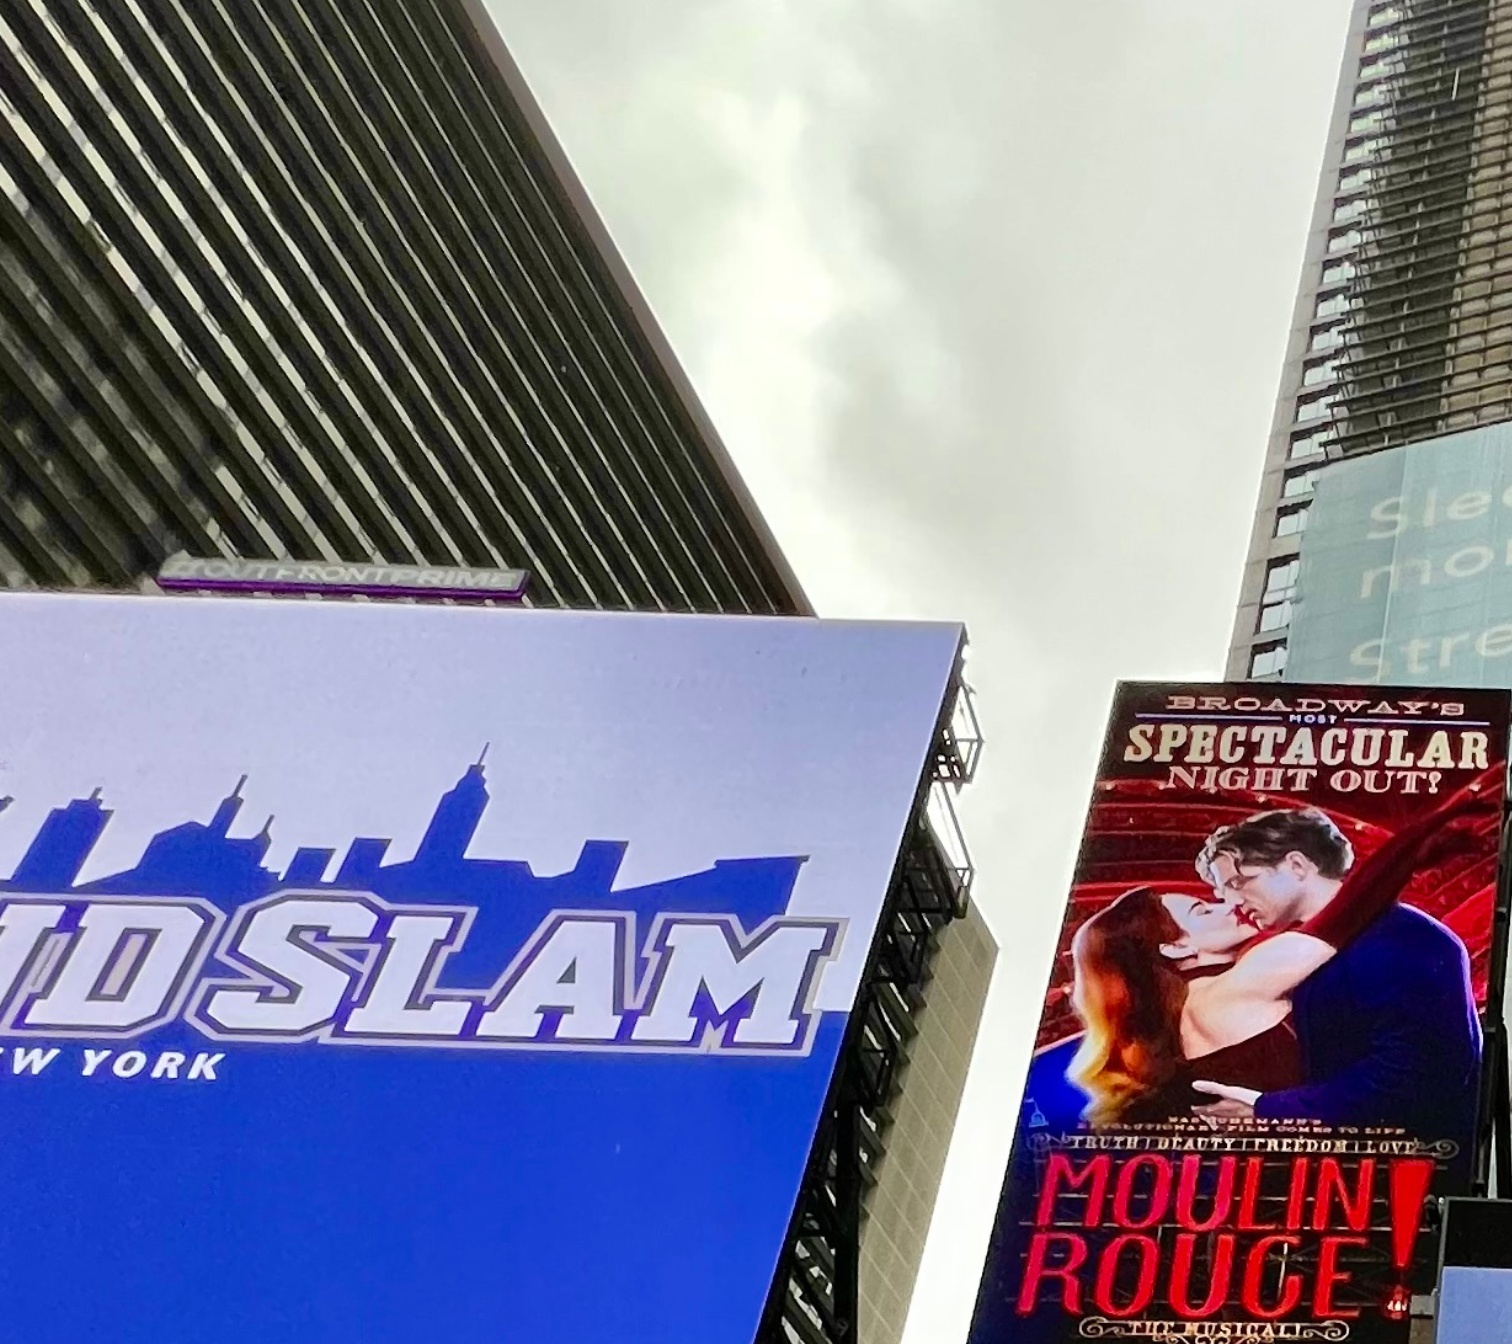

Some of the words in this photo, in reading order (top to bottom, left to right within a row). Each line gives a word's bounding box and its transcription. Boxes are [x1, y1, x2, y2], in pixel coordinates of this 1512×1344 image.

[1166, 696, 1465, 717] BROADWAY'S
[1289, 714, 1337, 724] MOST
[1124, 724, 1490, 770] SPECTACULAR
[1165, 766, 1317, 792] NIGHT
[1330, 770, 1441, 795] OUT!
[82, 1049, 225, 1080] YORK
[1072, 1135, 1140, 1150] TRUTH
[1158, 1136, 1234, 1152] BEAUTY
[1253, 1137, 1347, 1153] FREEDOM
[1366, 1139, 1416, 1154] LOVE
[1128, 1321, 1174, 1336] THE
[1184, 1322, 1302, 1338] MUSICAL
